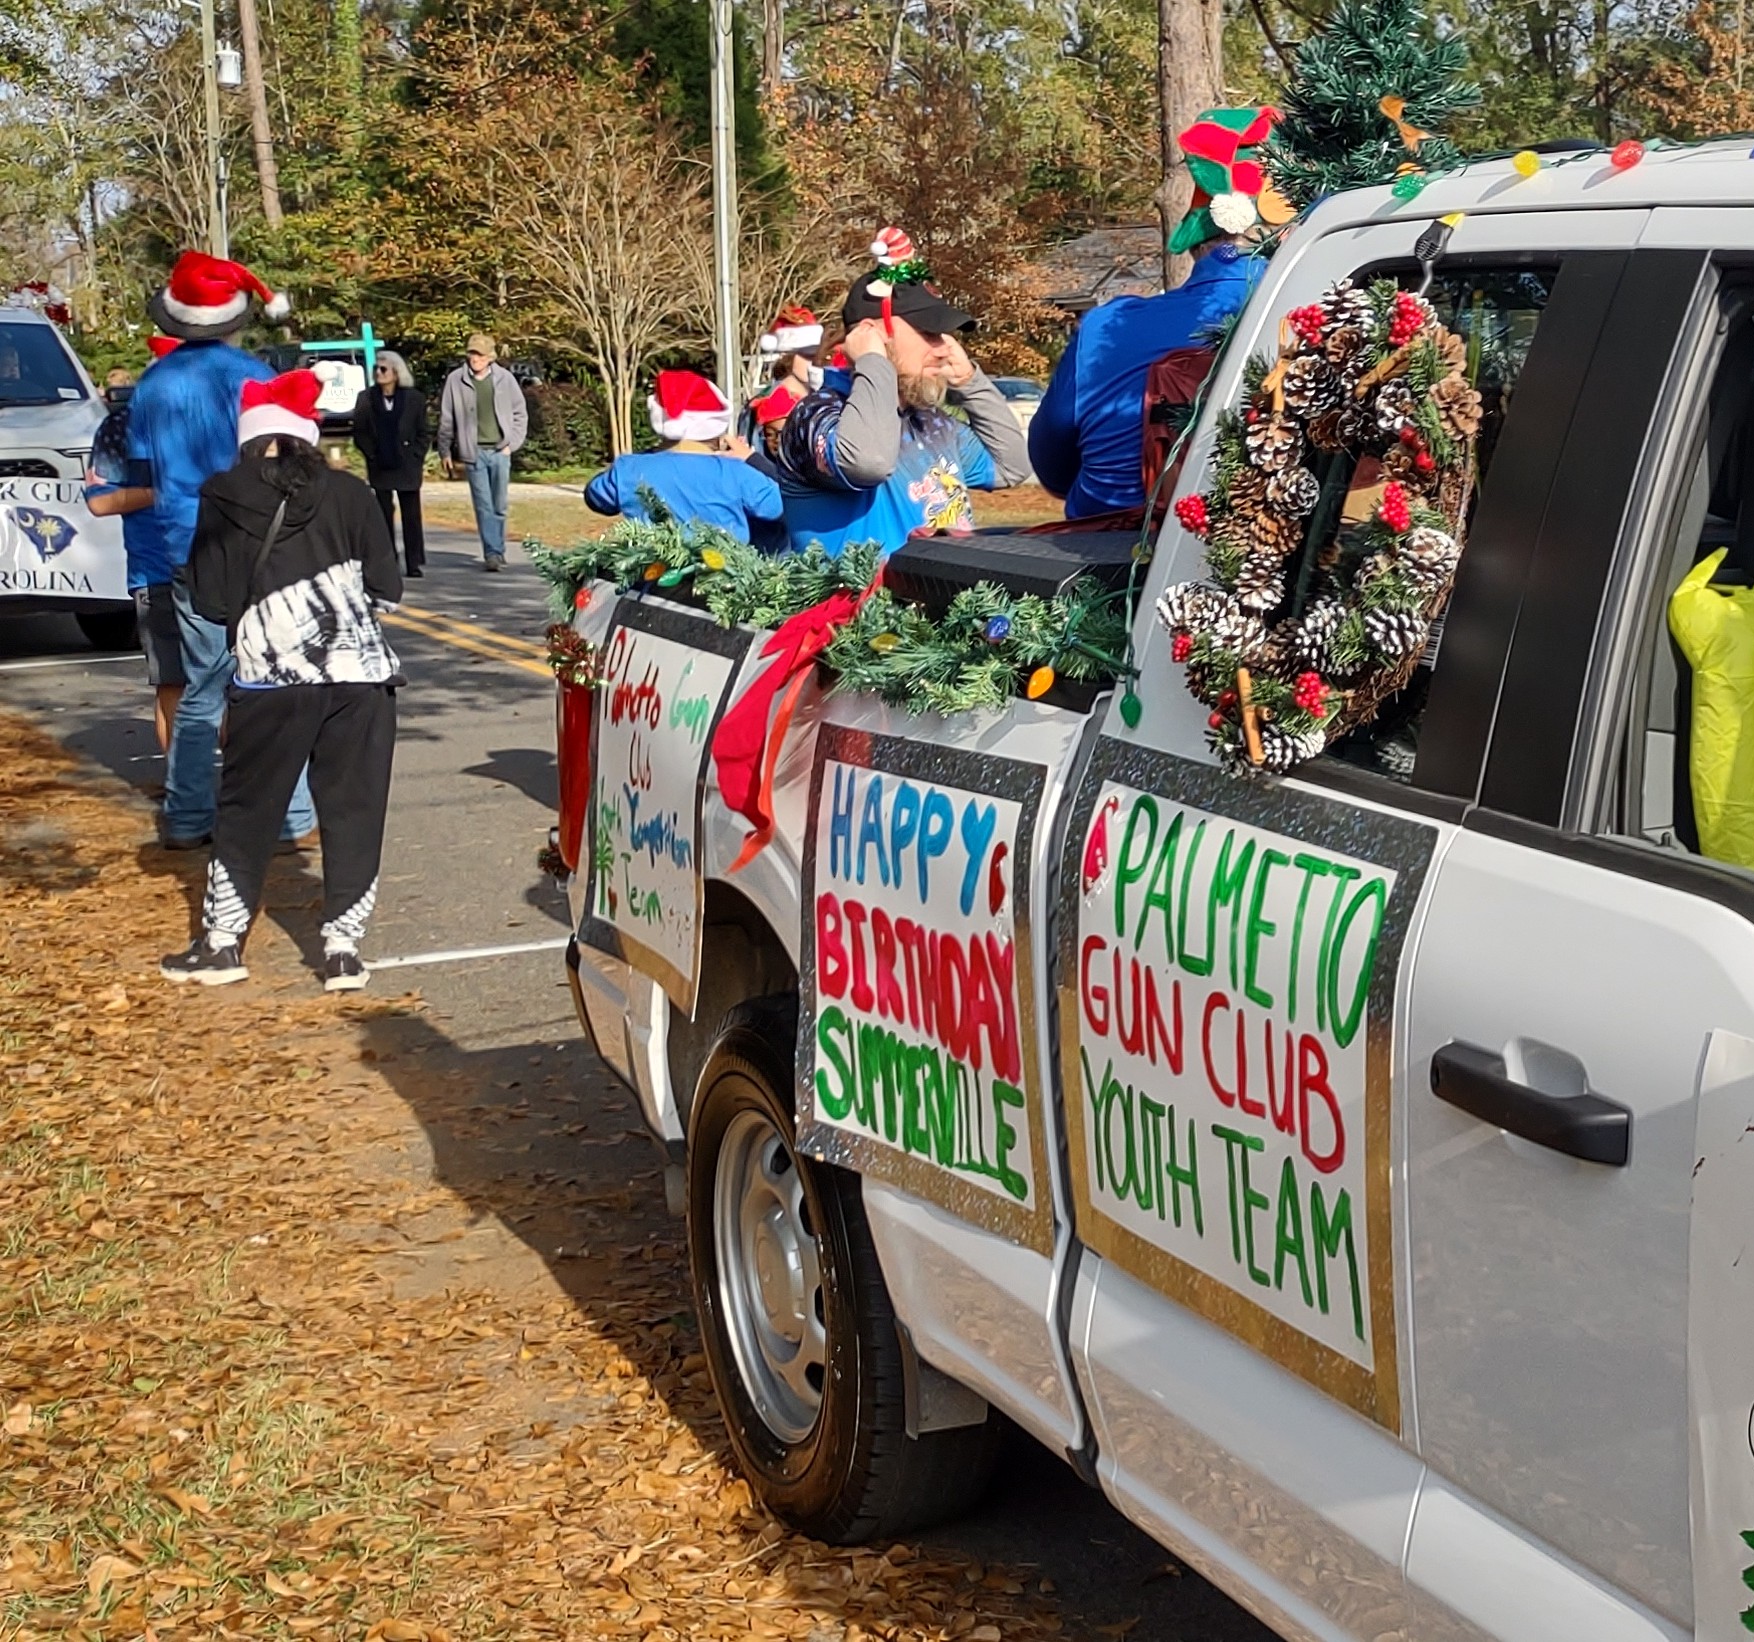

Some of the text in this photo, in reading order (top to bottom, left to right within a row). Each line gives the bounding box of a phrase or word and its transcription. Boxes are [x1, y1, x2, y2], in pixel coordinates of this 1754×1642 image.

[830, 764, 996, 917] HAPPY
[1114, 793, 1387, 1049] PALMETTO
[816, 891, 1022, 1086] BIRTHDAY
[1081, 935, 1345, 1175] GUN CLUB
[815, 1004, 1029, 1203] SUMMERVILLE
[1079, 1045, 1366, 1343] YOUTH TEAM
